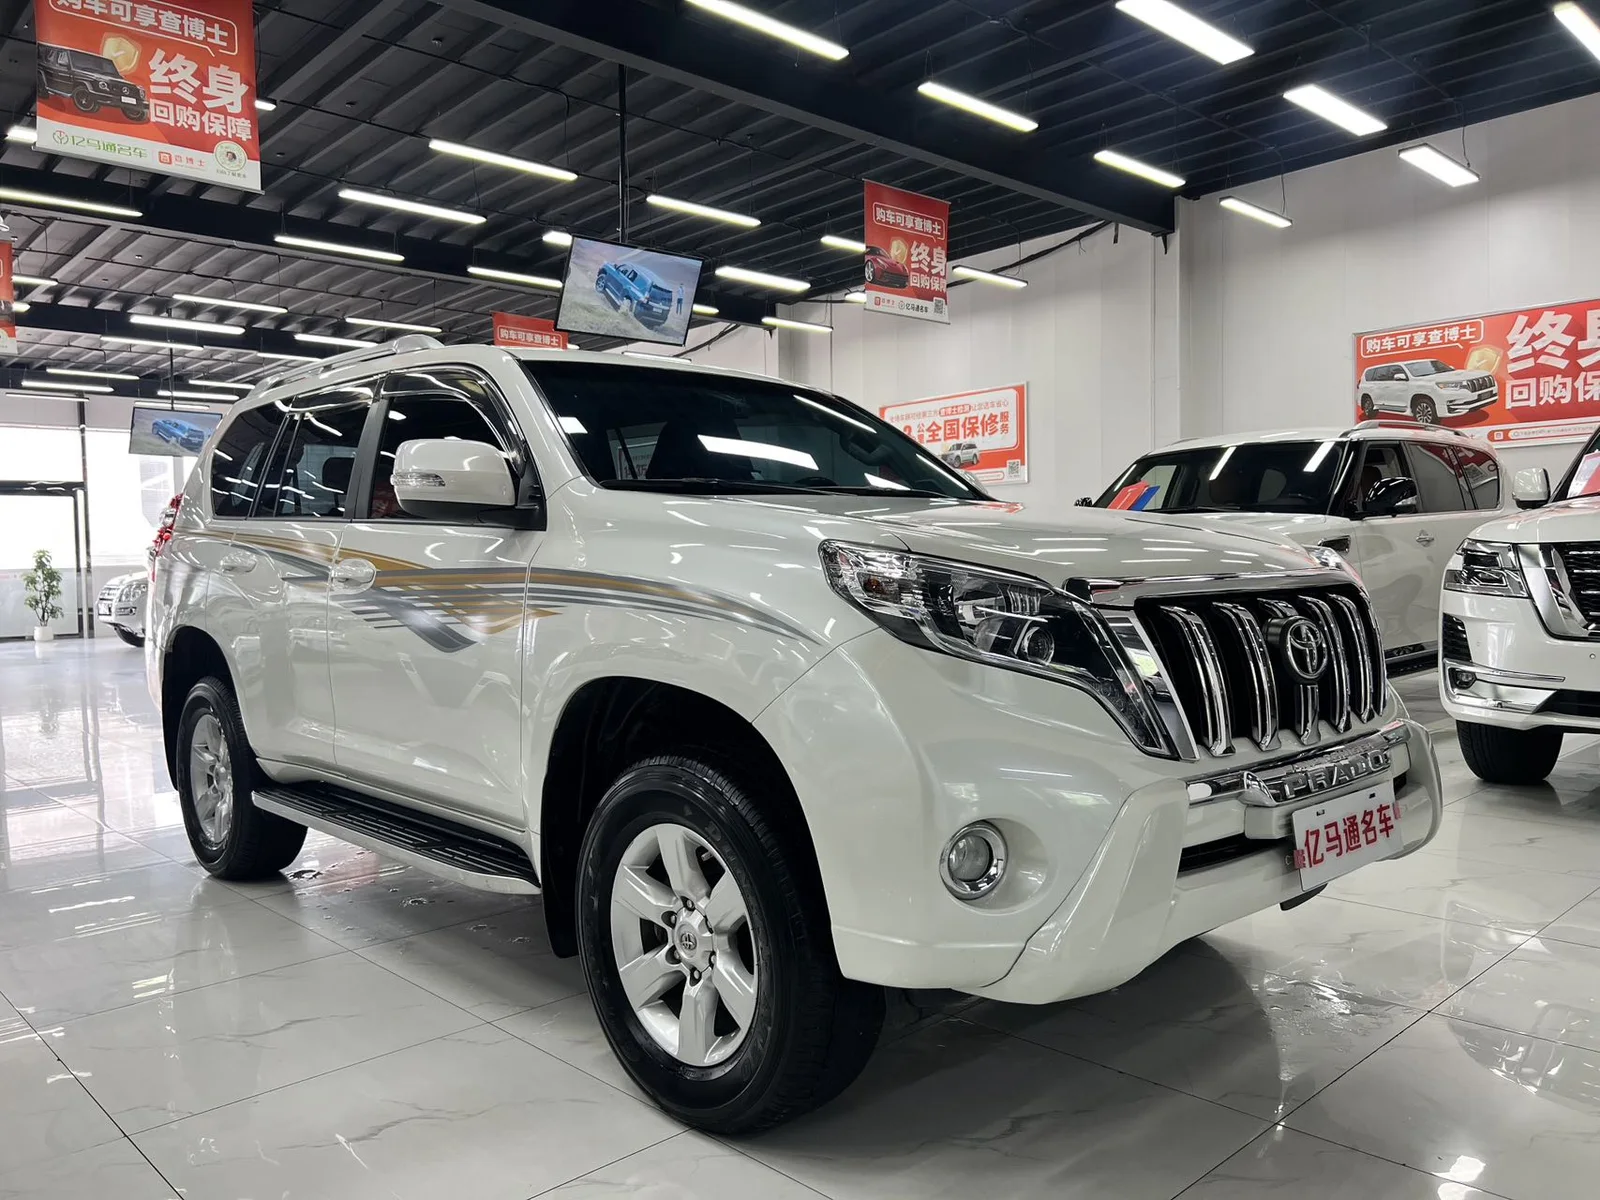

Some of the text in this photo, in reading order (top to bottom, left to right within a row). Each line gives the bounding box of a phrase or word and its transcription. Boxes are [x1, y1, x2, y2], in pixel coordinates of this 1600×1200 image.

[148, 48, 249, 113] 终身
[149, 99, 252, 142] 回购保障
[71, 135, 148, 159] 亿马通名车
[875, 207, 941, 235] 购车可享查博士
[911, 240, 947, 277] 终身
[1366, 324, 1477, 353] 购车可享查博士
[926, 412, 999, 443] 全国保修
[1284, 749, 1388, 799] PRADO
[1304, 804, 1394, 868] 亿马通名车
